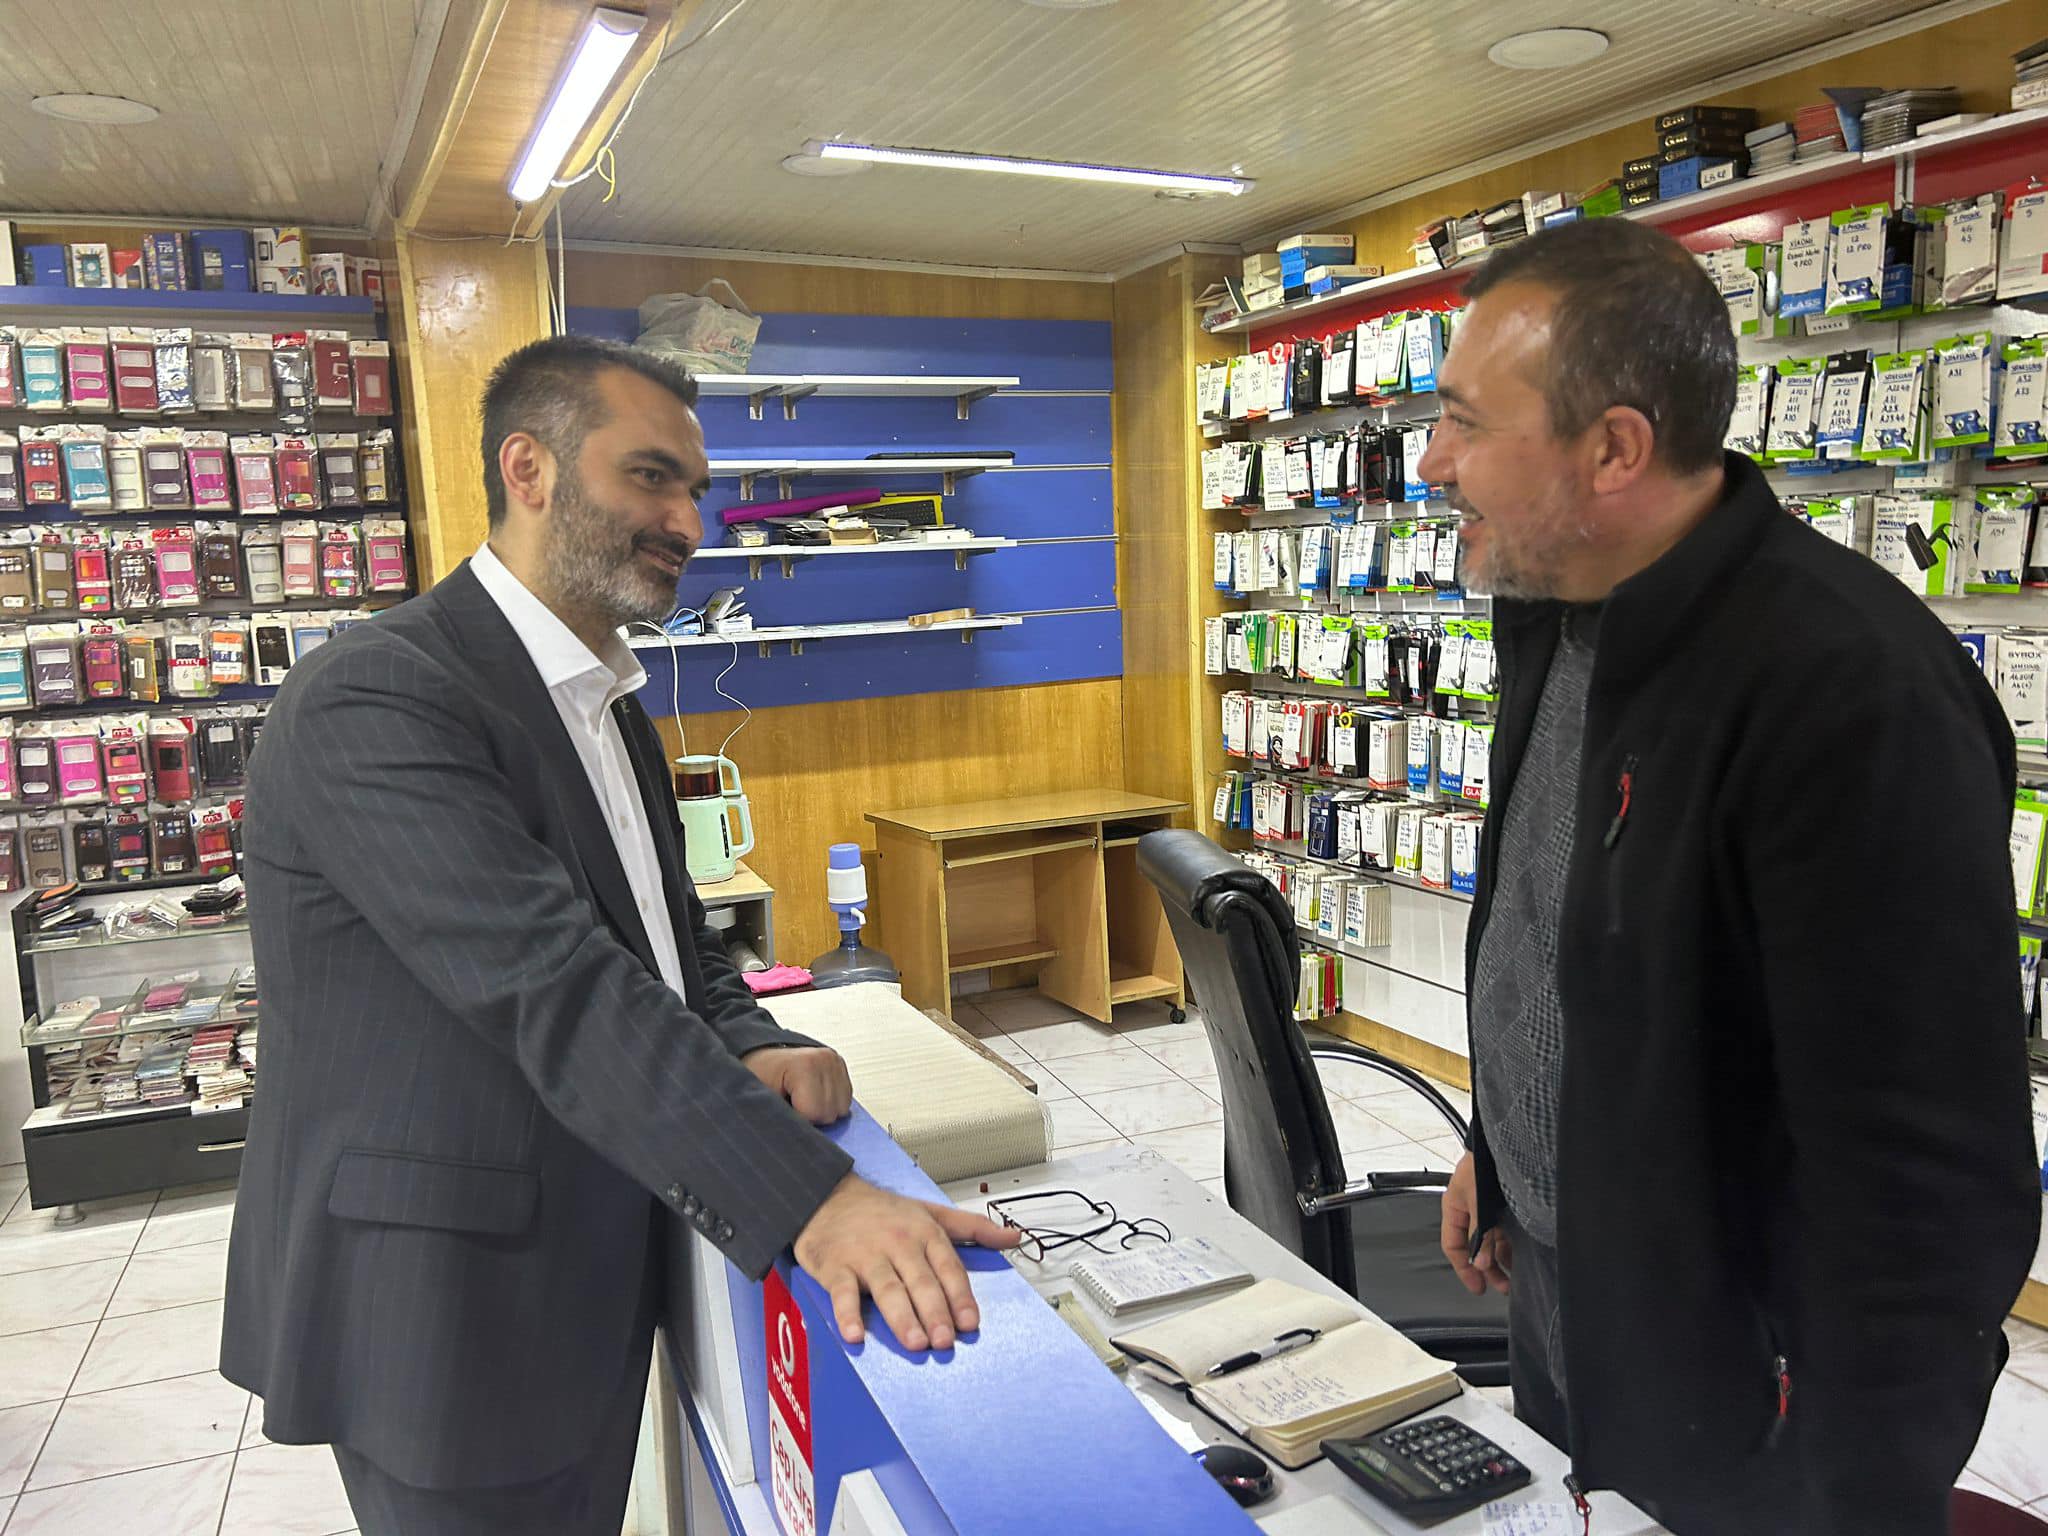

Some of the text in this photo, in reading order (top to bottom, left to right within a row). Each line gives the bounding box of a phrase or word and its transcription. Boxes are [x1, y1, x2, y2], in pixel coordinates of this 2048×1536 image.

[1782, 299, 1821, 311] GLASS
[1440, 779, 1460, 788] GLASS
[1465, 787, 1481, 796] GLA
[1454, 879, 1474, 889] GLASS
[771, 1354, 806, 1431] vodafone
[771, 1419, 814, 1529] Cep Lira
